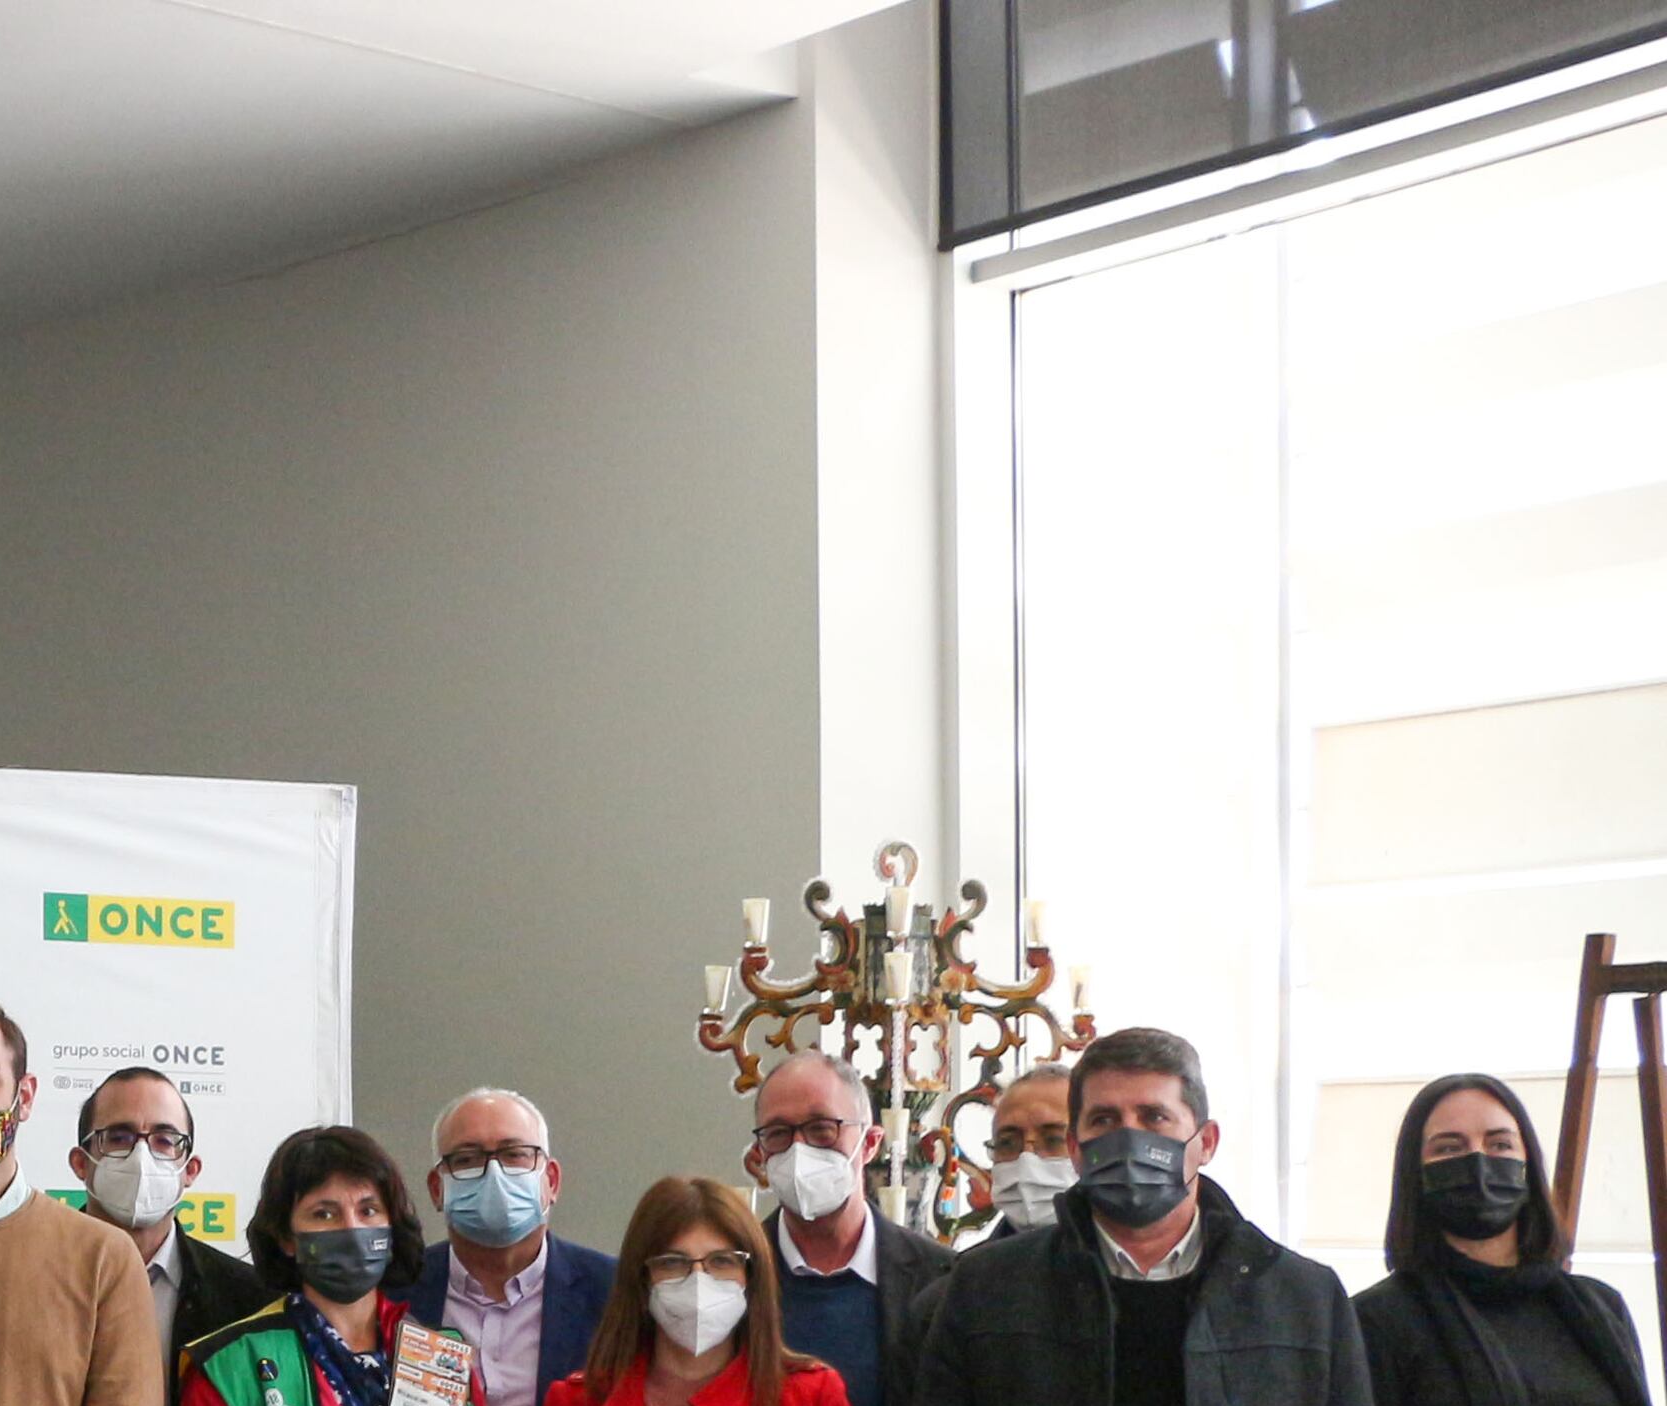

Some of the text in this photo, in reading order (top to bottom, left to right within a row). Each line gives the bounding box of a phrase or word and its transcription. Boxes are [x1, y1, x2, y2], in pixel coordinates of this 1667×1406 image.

[98, 903, 226, 941] ONCE
[53, 1044, 225, 1065] grupo social ONCE
[192, 1084, 223, 1093] ONCE
[176, 1201, 225, 1233] CE
